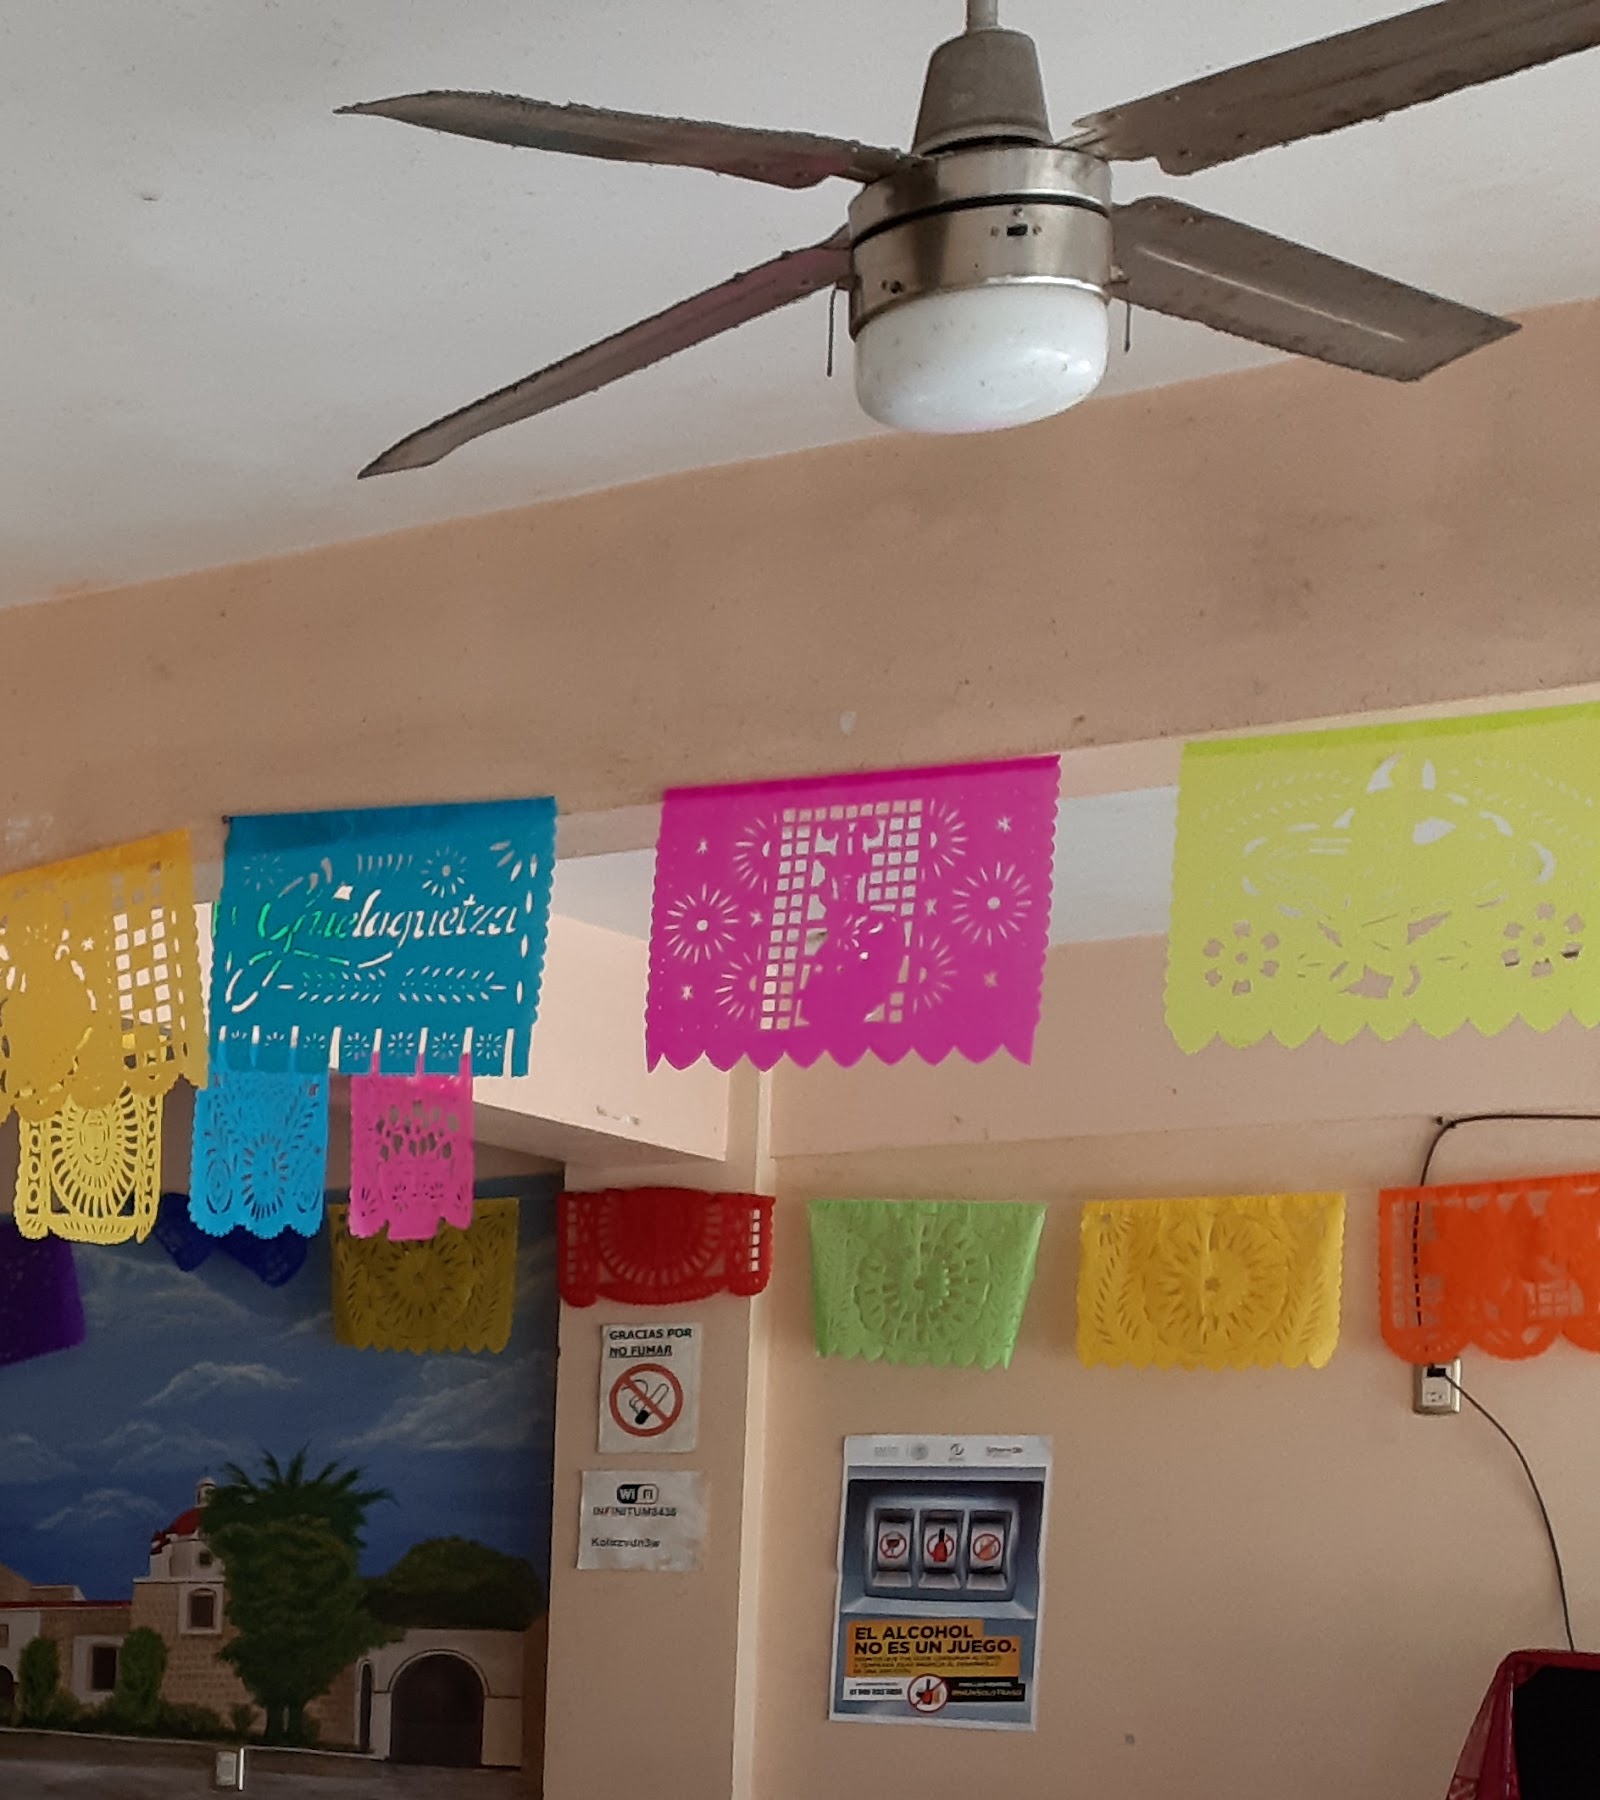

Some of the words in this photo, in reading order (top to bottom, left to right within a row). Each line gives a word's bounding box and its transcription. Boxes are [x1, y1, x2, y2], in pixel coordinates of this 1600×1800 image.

[609, 1328, 663, 1340] GRACIAS
[667, 1328, 692, 1338] POR
[610, 1347, 627, 1358] NO
[631, 1345, 672, 1358] FUMAR
[855, 1627, 877, 1640] EL
[883, 1625, 973, 1640] ALCOHOL
[854, 1642, 883, 1655] NO
[888, 1641, 911, 1655] ES
[916, 1641, 943, 1654] UN
[947, 1639, 1017, 1654] JUEGO.
